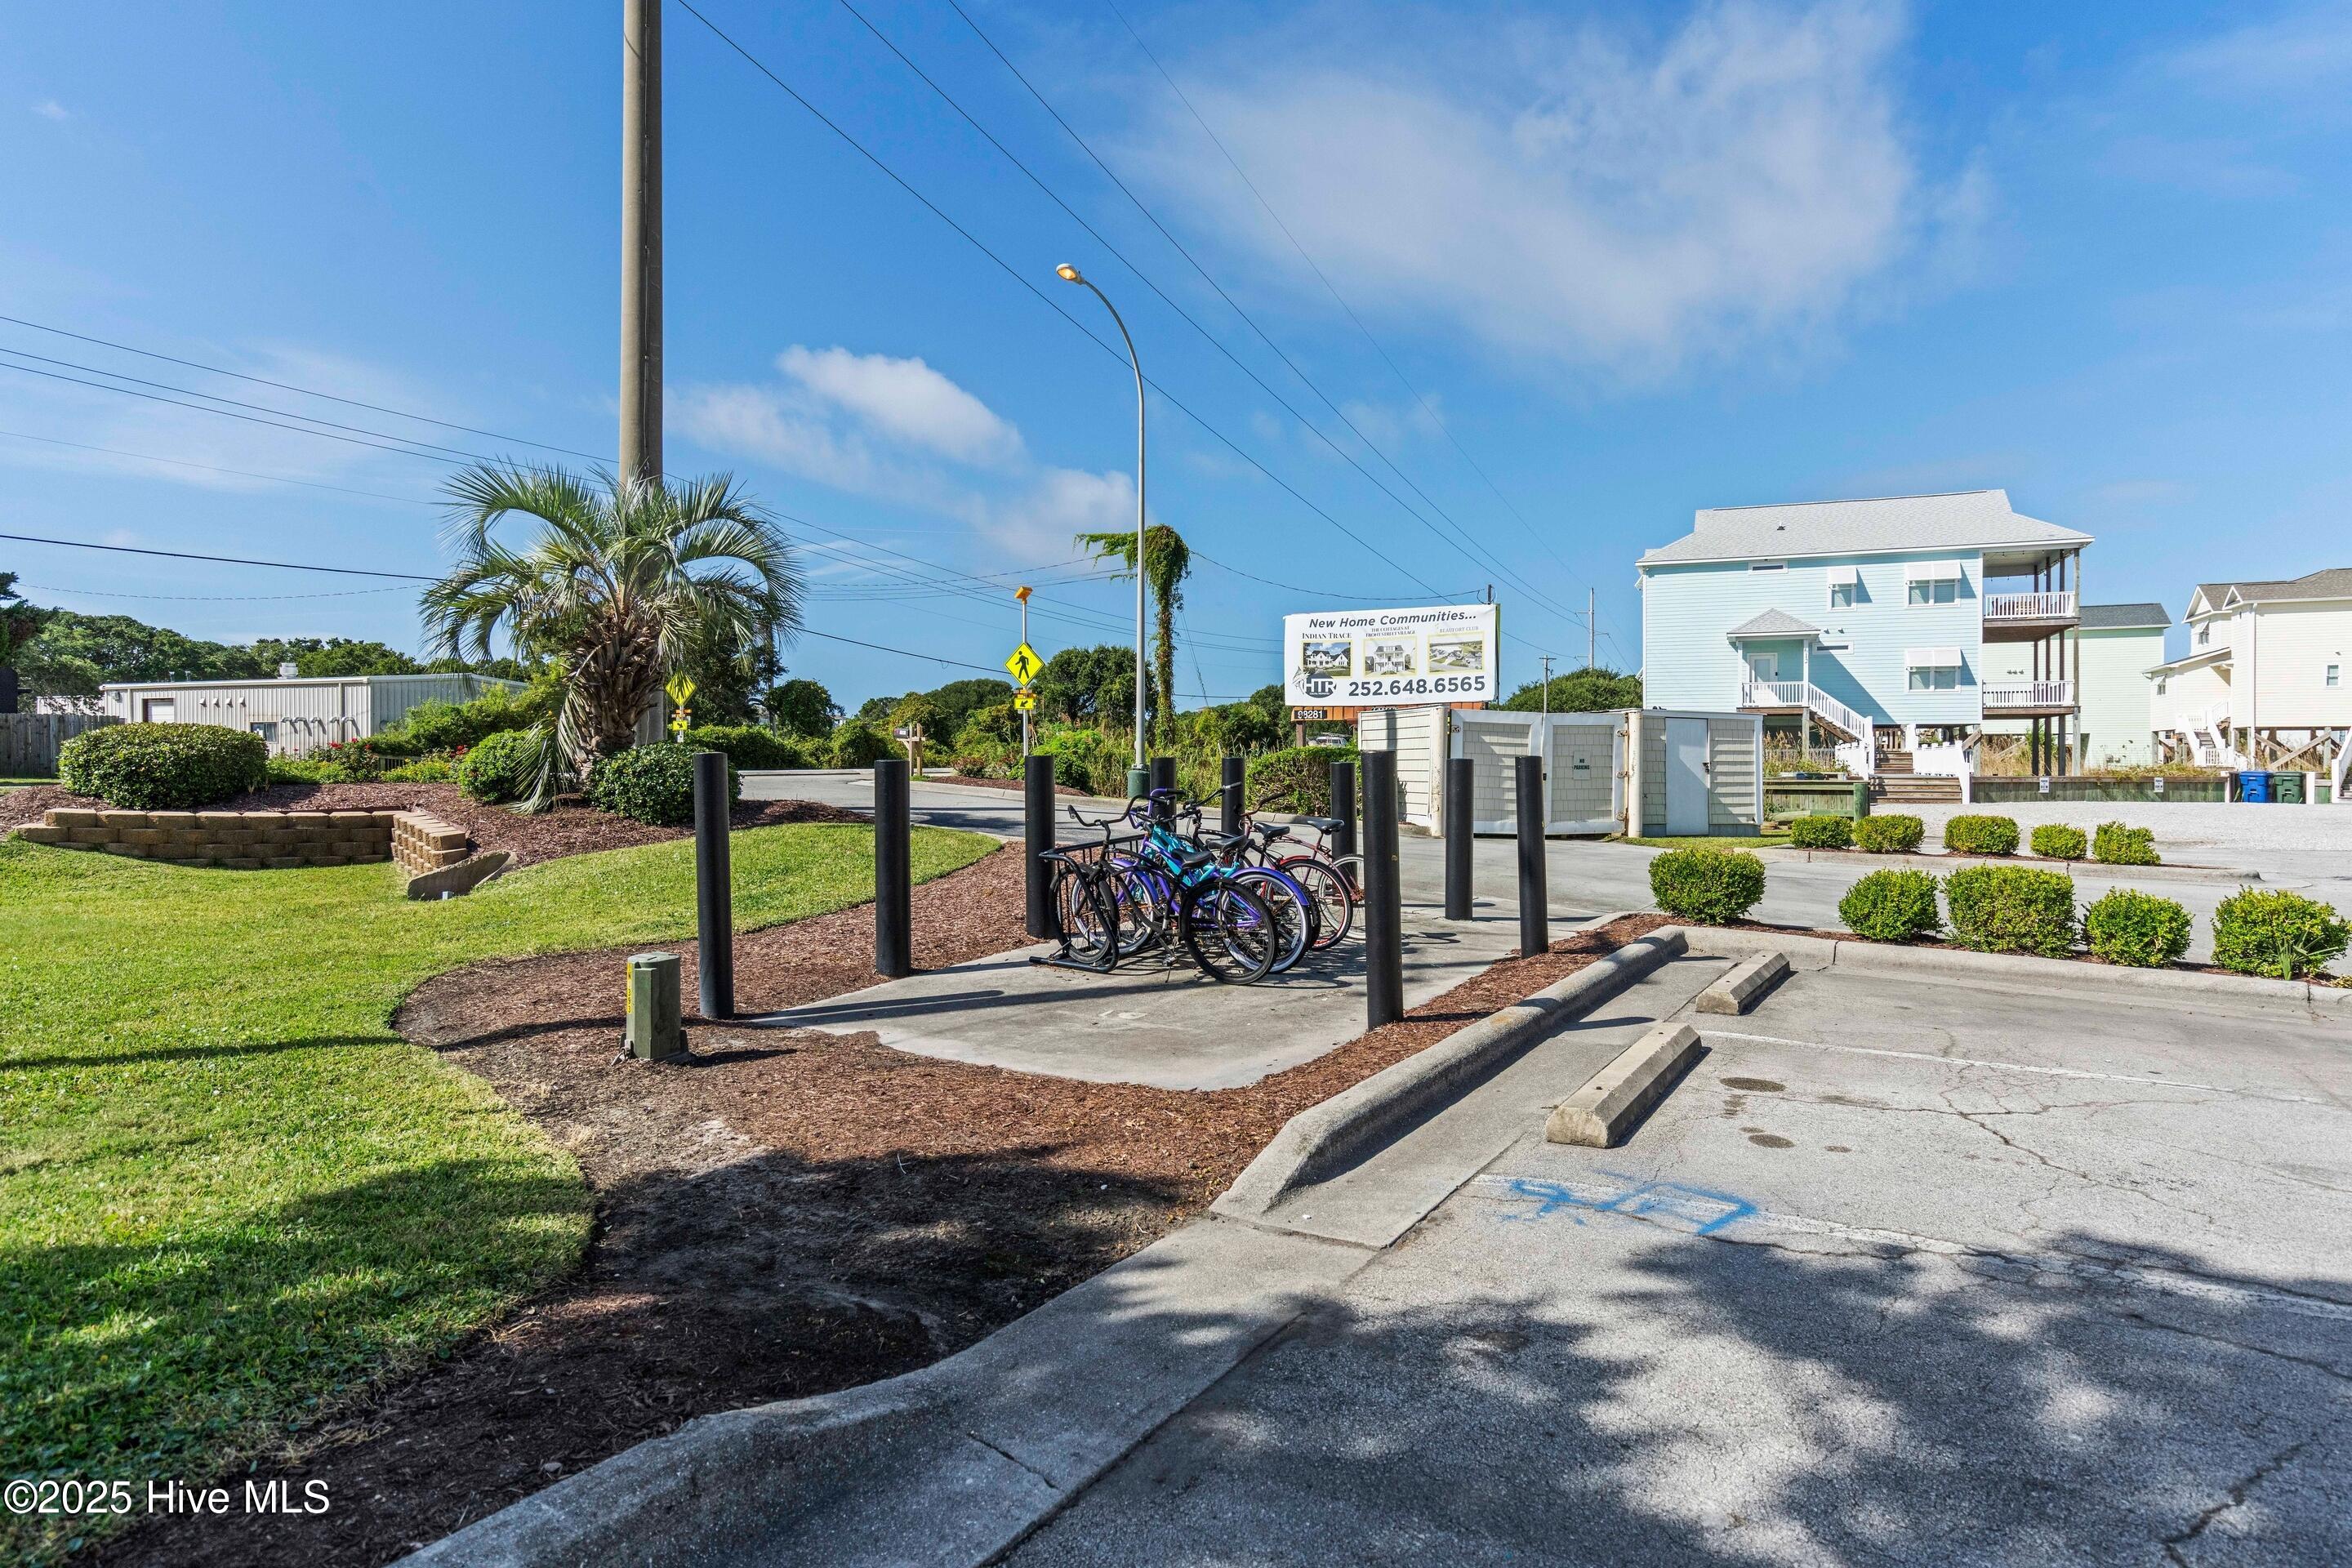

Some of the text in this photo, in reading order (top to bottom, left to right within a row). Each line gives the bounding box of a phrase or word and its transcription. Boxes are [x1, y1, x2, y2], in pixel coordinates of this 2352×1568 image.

[1309, 611, 1477, 628] New Home Communities...
[1348, 675, 1486, 697] 252.648.6565
[1297, 710, 1323, 719] 98281
